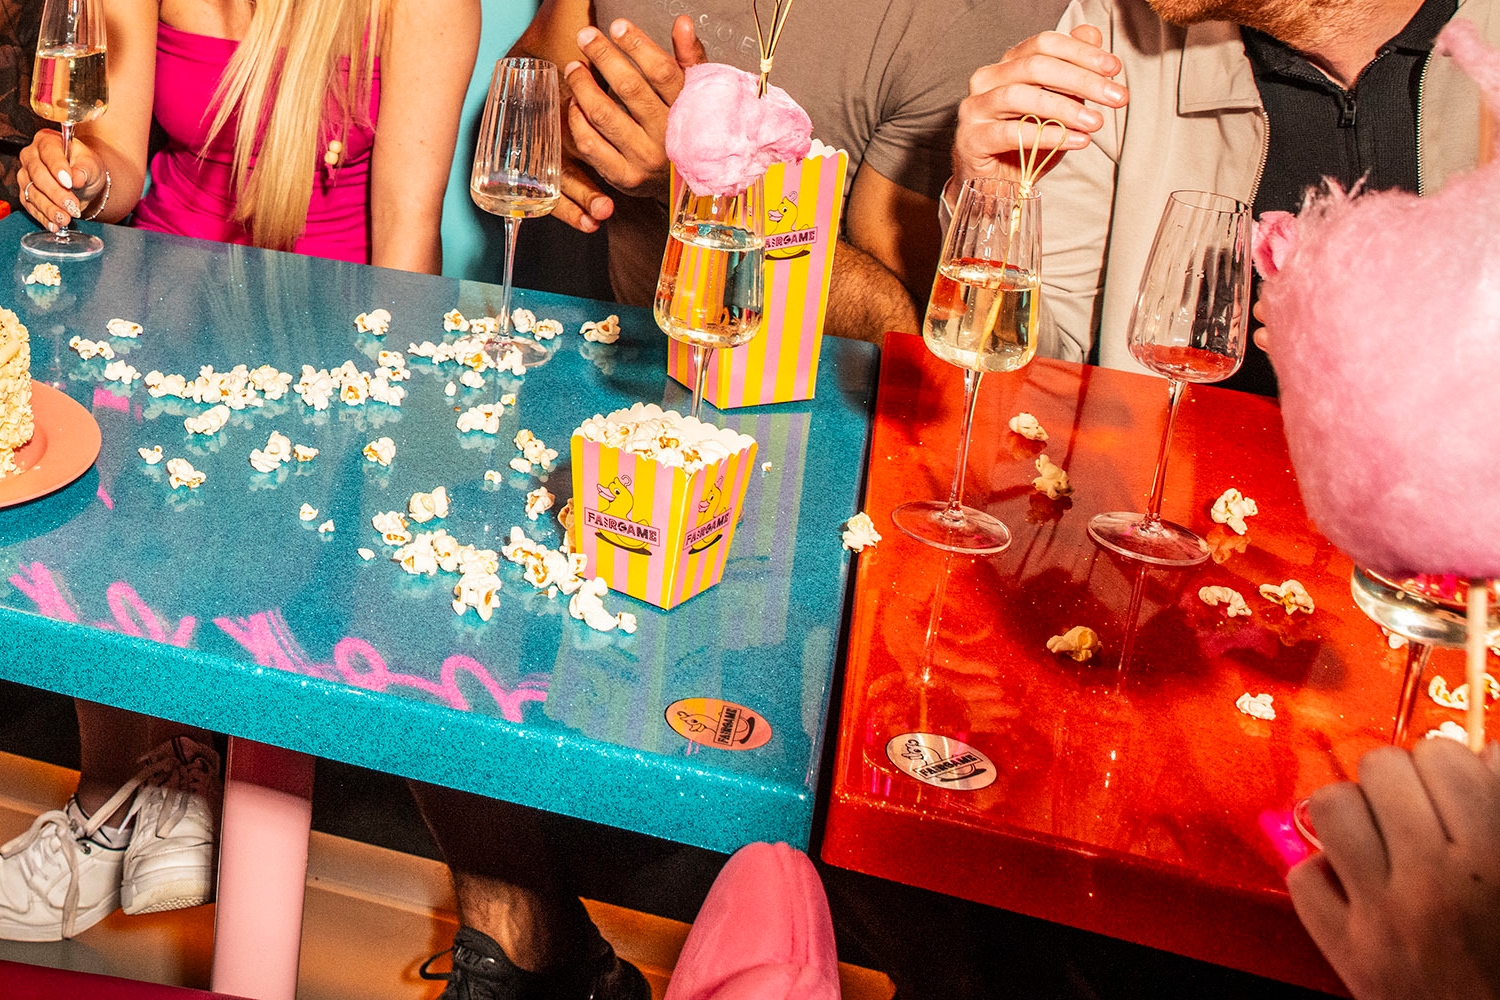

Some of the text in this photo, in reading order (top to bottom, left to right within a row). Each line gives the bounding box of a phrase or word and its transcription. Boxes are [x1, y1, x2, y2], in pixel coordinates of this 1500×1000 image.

[765, 230, 816, 248] AIRGAME
[587, 511, 658, 542] FAIRGAME
[685, 512, 730, 546] FAIRGAME
[717, 707, 738, 744] FAIRGAME
[919, 753, 978, 778] FAIRGAME
